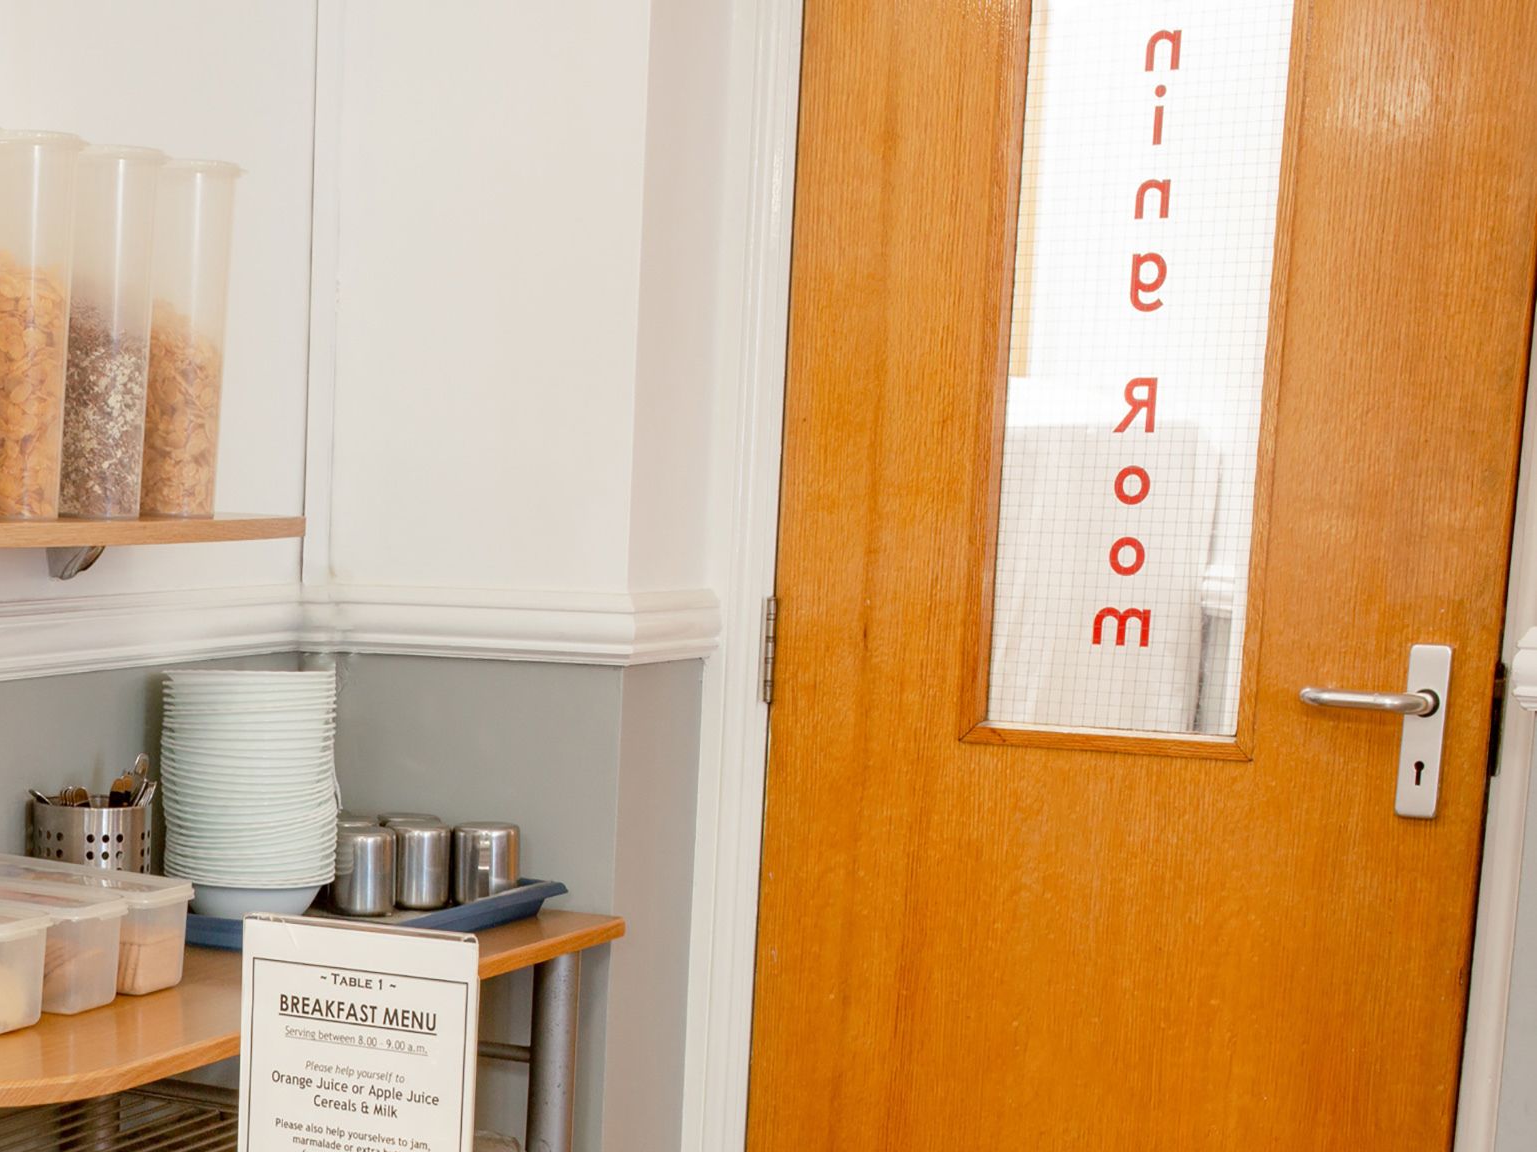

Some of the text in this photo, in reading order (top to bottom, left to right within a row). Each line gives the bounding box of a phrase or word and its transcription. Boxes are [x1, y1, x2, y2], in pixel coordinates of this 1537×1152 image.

[378, 979, 383, 990] 1
[280, 994, 437, 1031] BREAKFAST MENU
[285, 1025, 315, 1040] Serving
[318, 1030, 355, 1044] between
[358, 1036, 377, 1047] 8.00
[386, 1040, 405, 1051] 9.00
[408, 1043, 428, 1054] a.m.
[305, 1060, 405, 1083] Please help yourself to
[272, 1070, 439, 1105] Orange Juice or Apple Juice
[314, 1095, 398, 1118] Cereals & Milk
[275, 1118, 430, 1152] Please also help yourselves to jam,
[293, 1135, 341, 1151] marmalade
[344, 1144, 353, 1152] or
